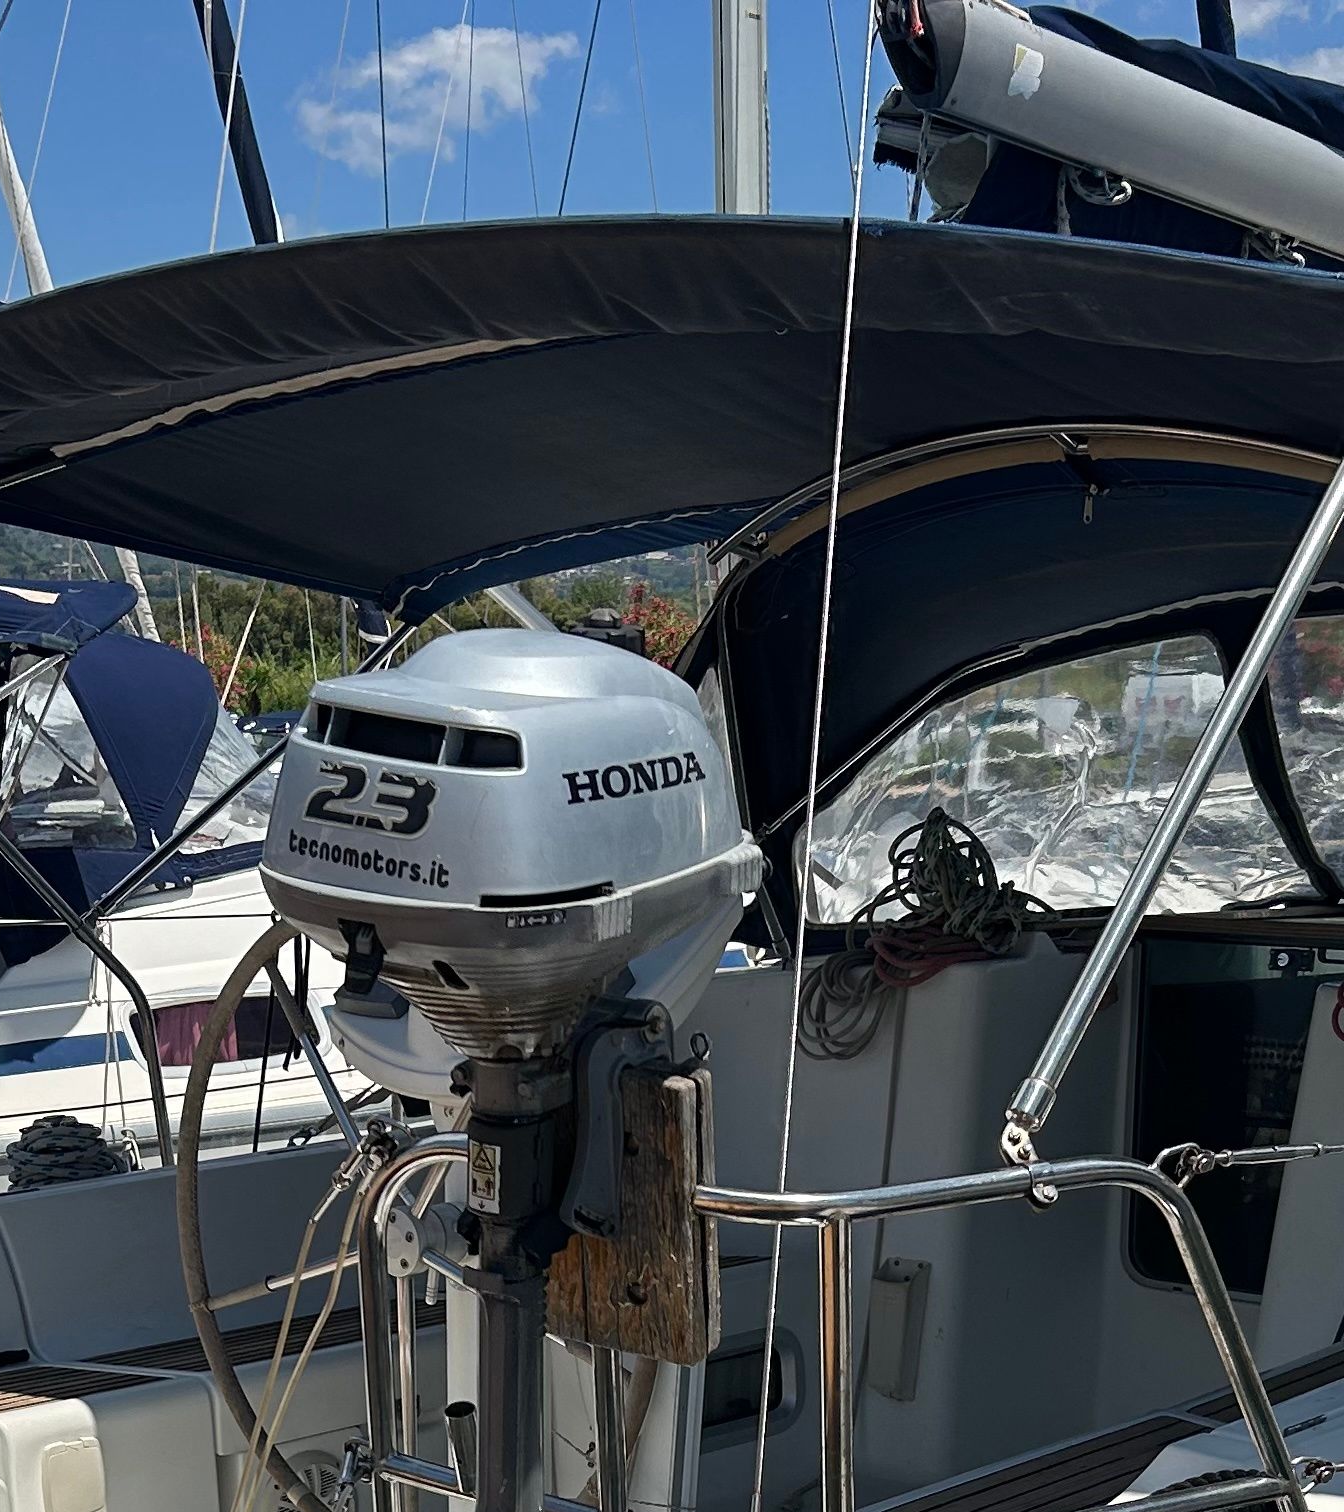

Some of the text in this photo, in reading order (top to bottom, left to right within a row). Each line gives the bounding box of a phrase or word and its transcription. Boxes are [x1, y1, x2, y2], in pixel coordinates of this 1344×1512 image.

[303, 760, 440, 839] 23
[562, 752, 706, 805] HONDA
[288, 828, 451, 888] tecnomotors.it
